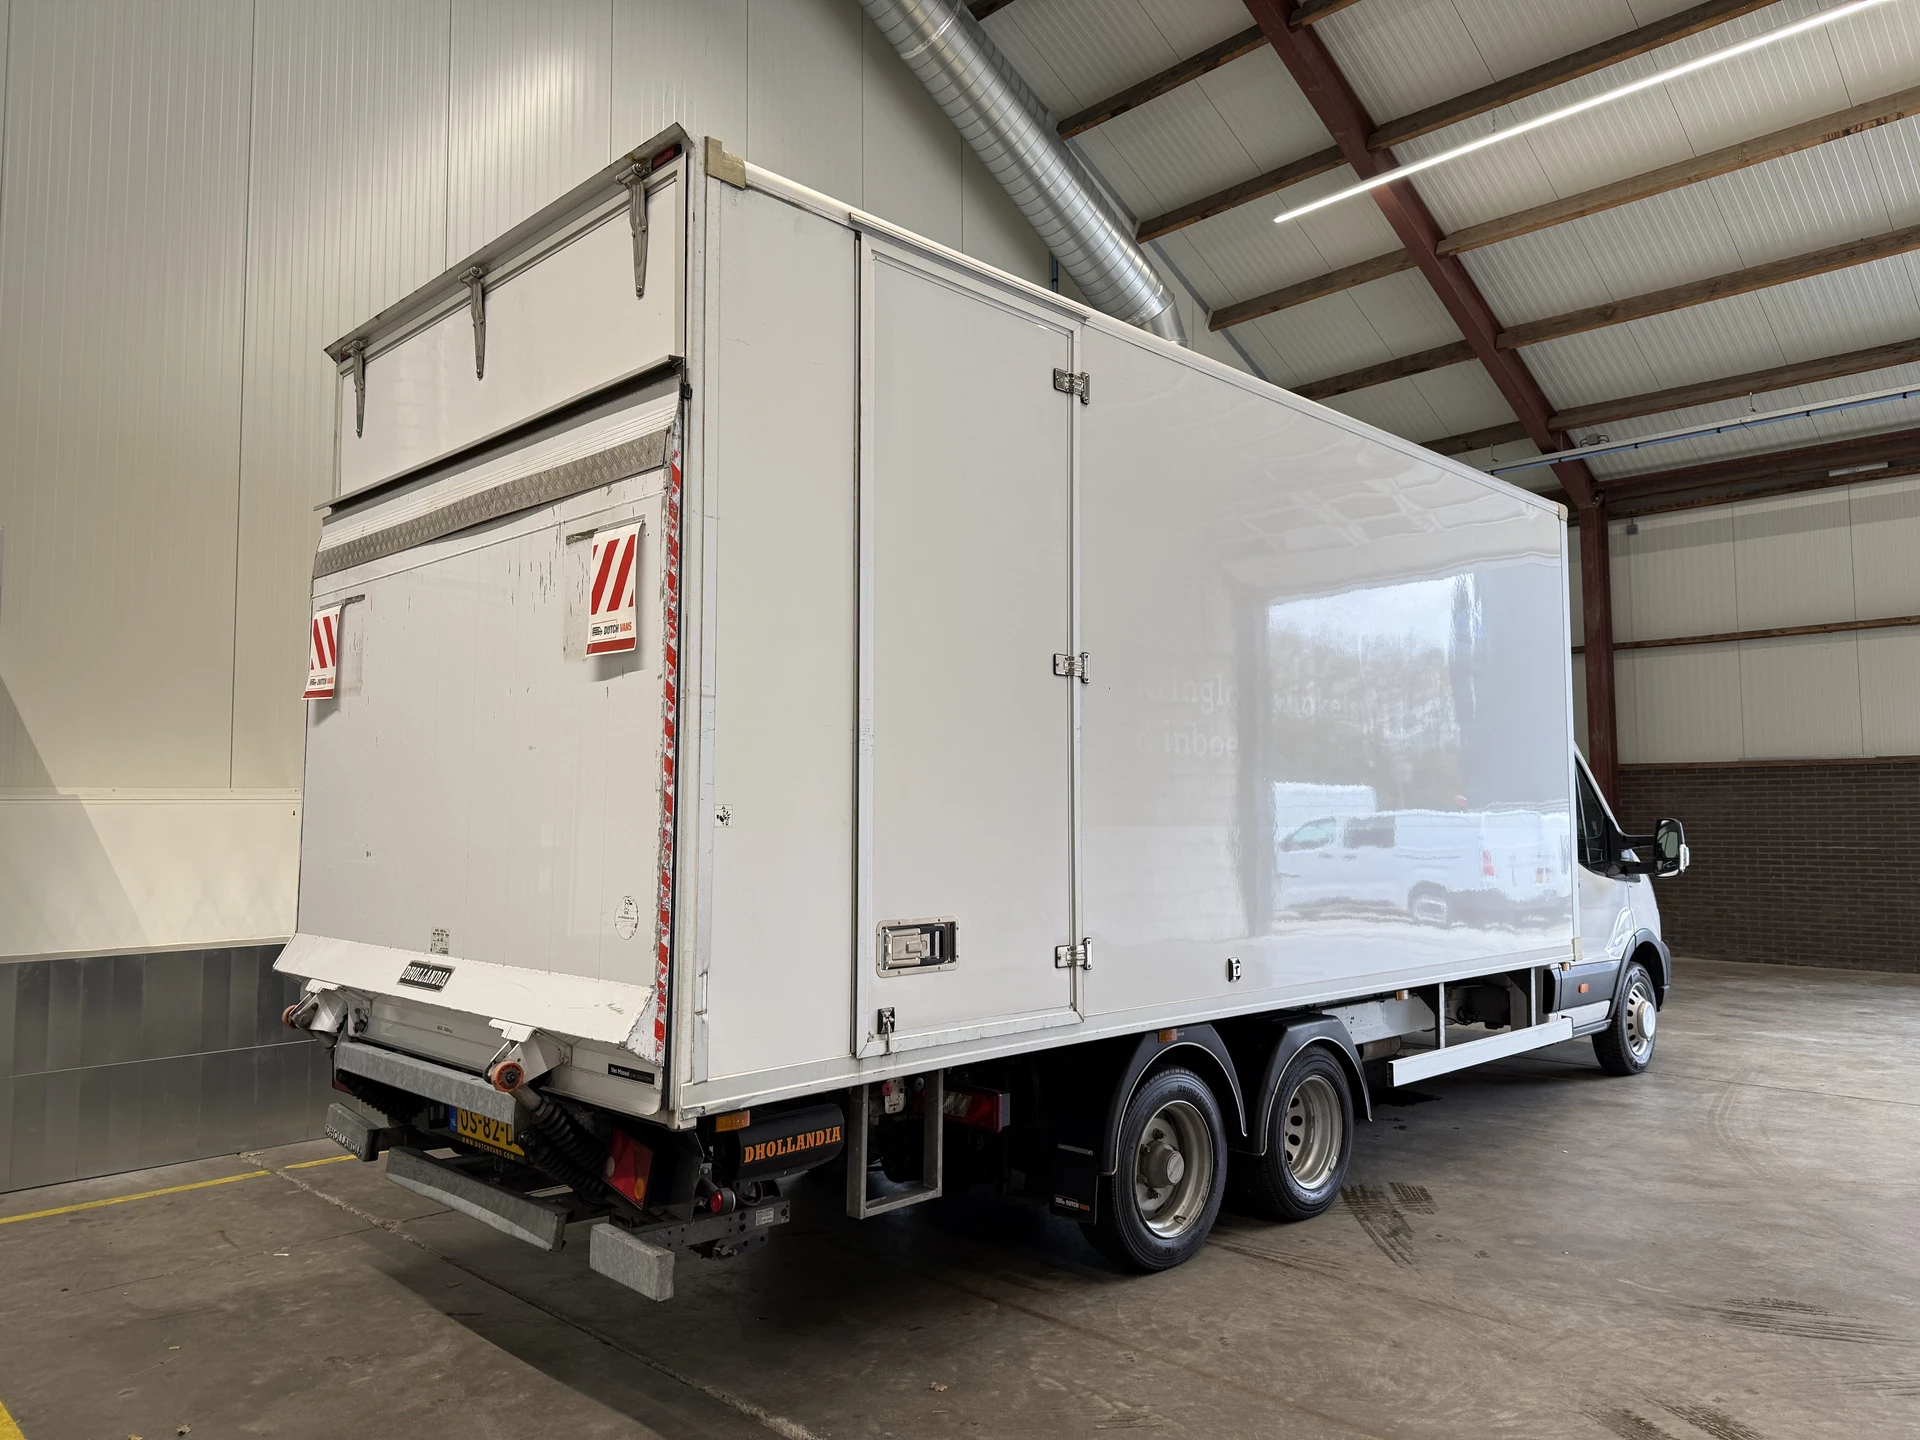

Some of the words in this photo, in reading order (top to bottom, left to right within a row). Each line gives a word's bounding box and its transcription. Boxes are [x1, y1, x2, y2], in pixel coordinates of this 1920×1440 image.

[603, 623, 619, 635] DUTCH
[620, 621, 632, 632] VANS
[401, 965, 450, 986] DHOLLANDIA
[744, 1126, 842, 1163] DHOLLANDIA
